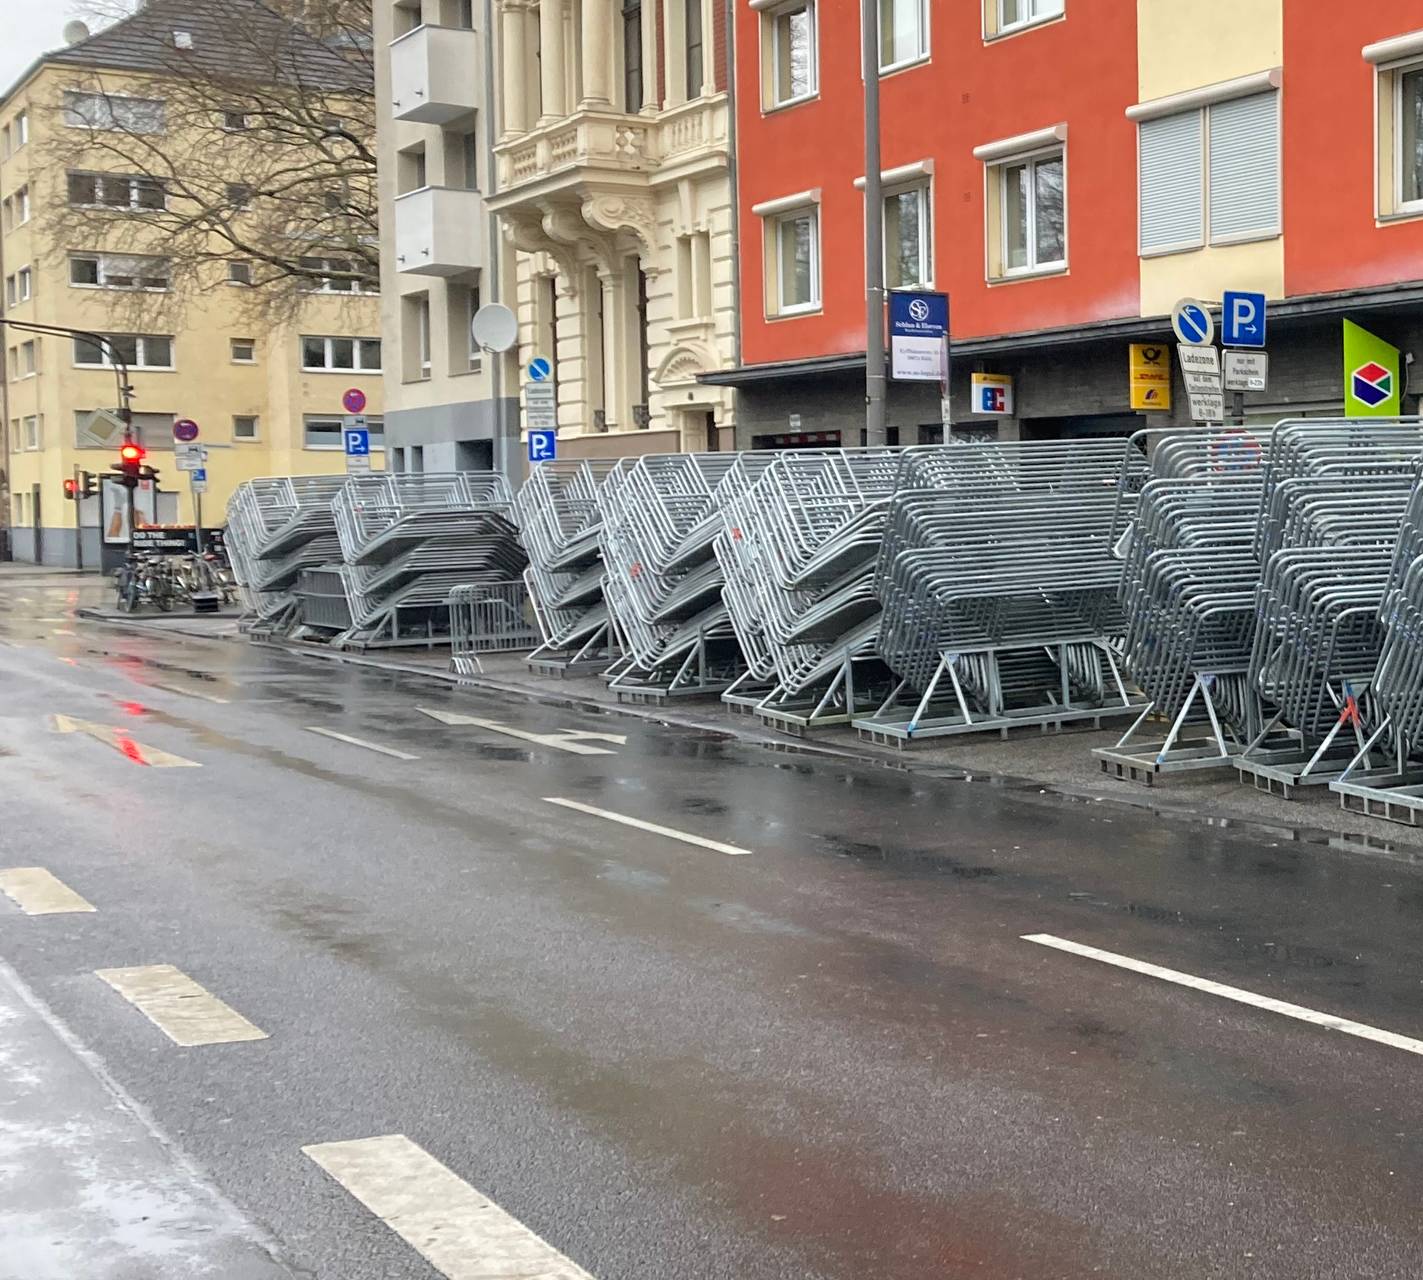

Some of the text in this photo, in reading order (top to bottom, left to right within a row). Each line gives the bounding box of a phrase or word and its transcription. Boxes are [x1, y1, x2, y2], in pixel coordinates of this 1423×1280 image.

[1232, 298, 1256, 338] P
[1183, 352, 1214, 365] Ladezone
[347, 432, 362, 453] P
[532, 434, 547, 458] P
